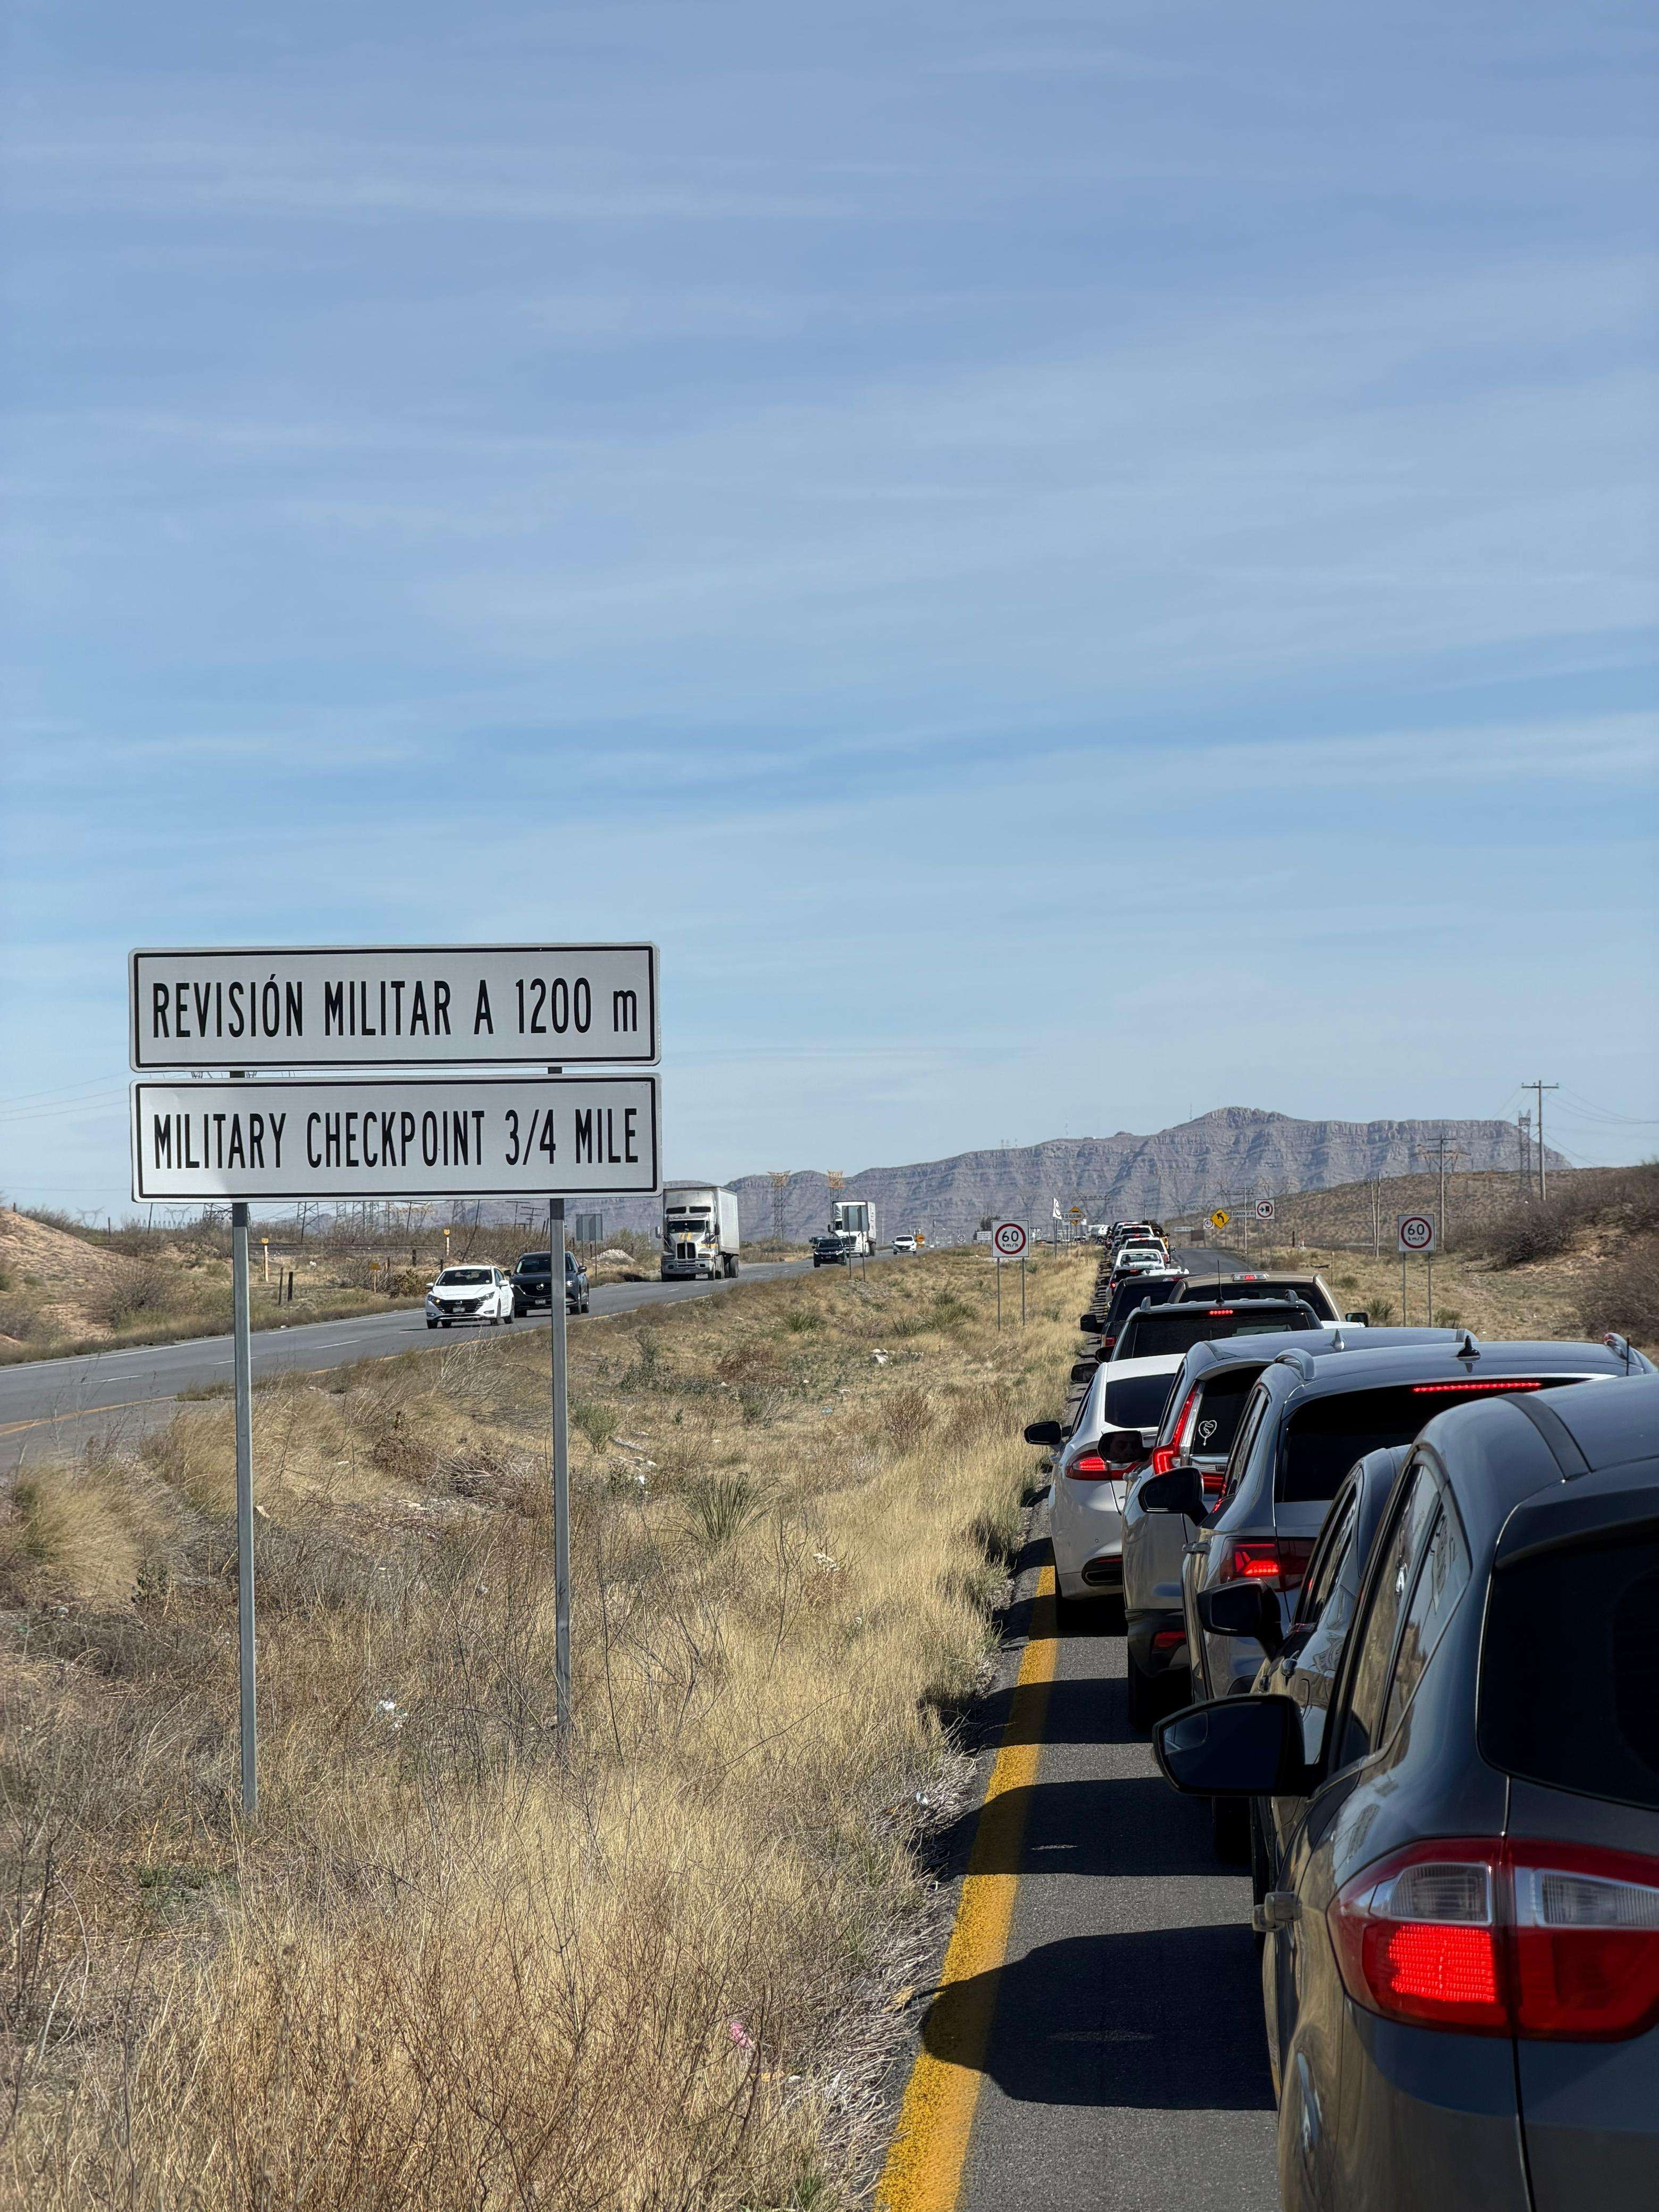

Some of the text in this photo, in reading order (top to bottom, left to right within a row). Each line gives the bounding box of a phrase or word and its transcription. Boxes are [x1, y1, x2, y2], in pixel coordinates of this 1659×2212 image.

[153, 973, 637, 1038] REVISIÓN MILITAR A 1200 m
[154, 1108, 639, 1169] MILITARY CHECKPOINT 3/4 MILE
[1002, 1230, 1019, 1242] 60
[1407, 1224, 1425, 1236] 60
